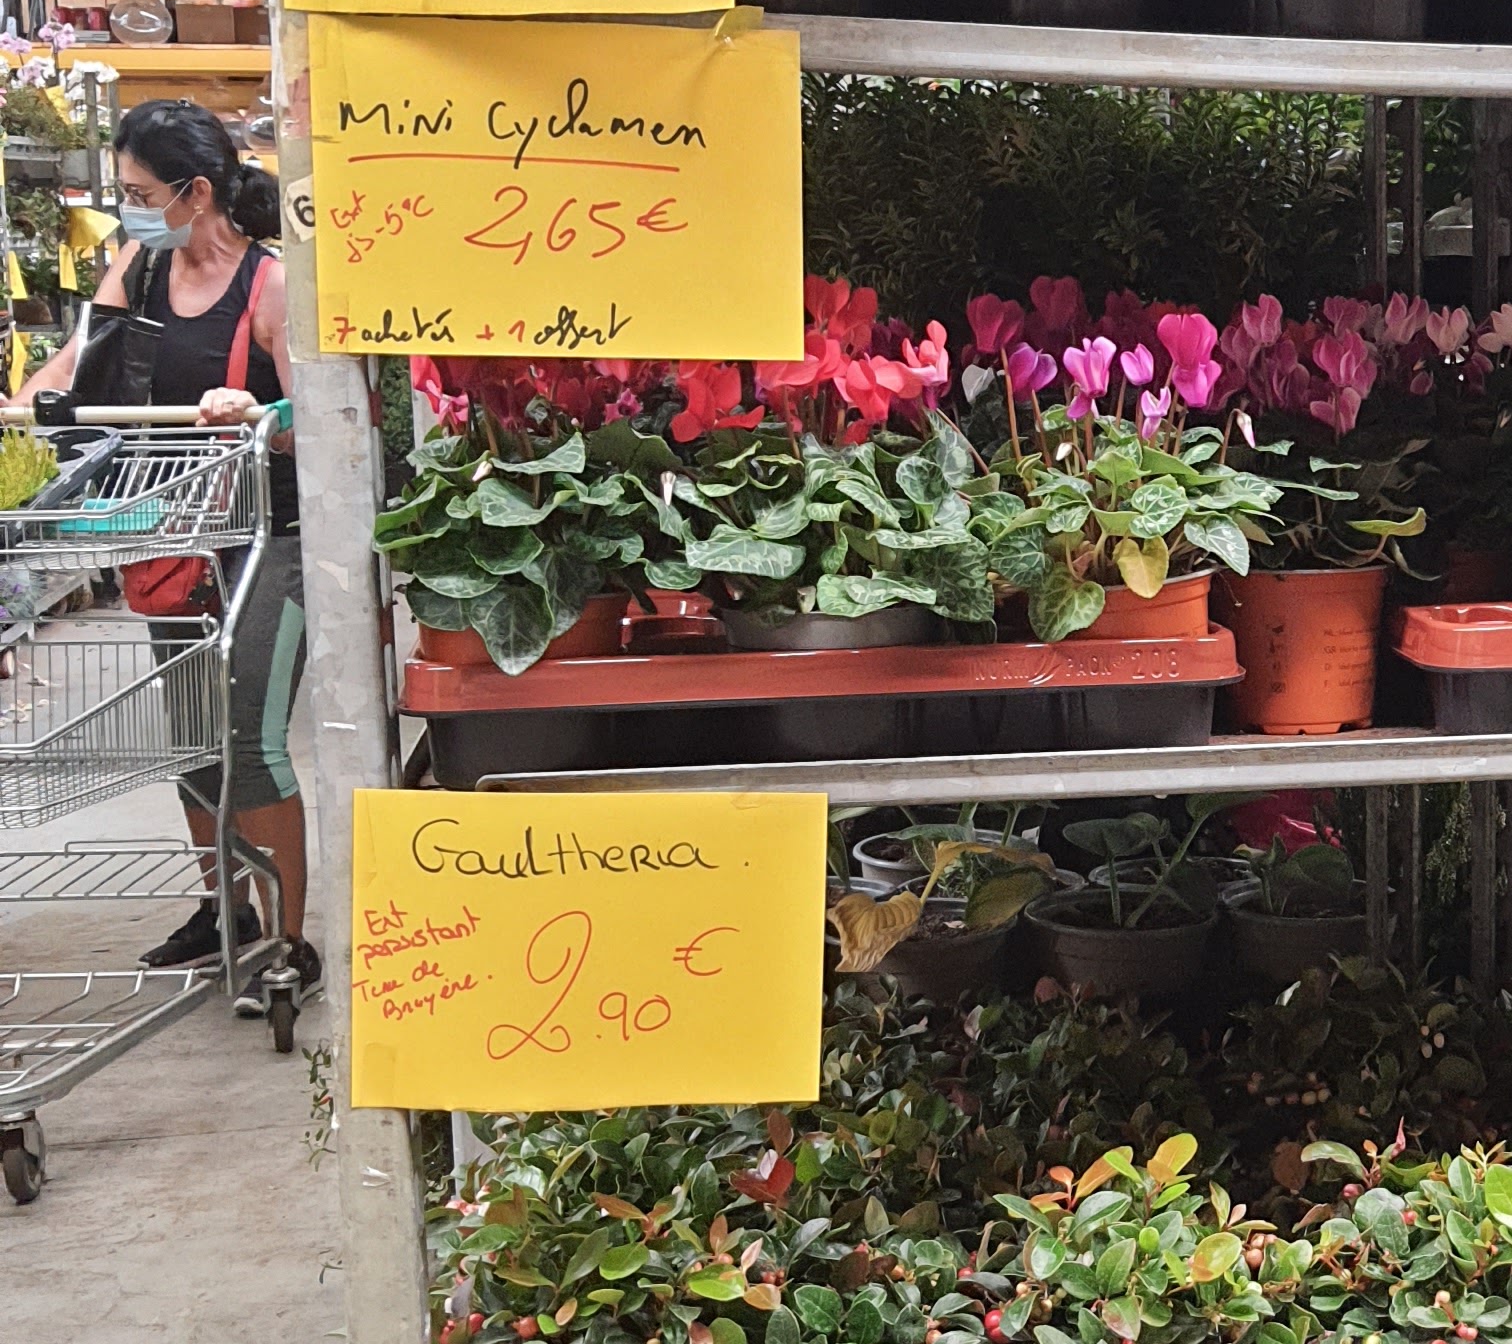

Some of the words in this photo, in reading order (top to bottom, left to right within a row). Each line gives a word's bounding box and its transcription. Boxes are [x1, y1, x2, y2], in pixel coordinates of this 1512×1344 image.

[488, 78, 706, 170] Cyclamen
[332, 316, 357, 345] 7
[507, 320, 526, 343] 1
[1130, 648, 1180, 681] 208
[412, 959, 446, 983] de
[485, 910, 673, 1061] 2.90
[671, 926, 741, 978] €
